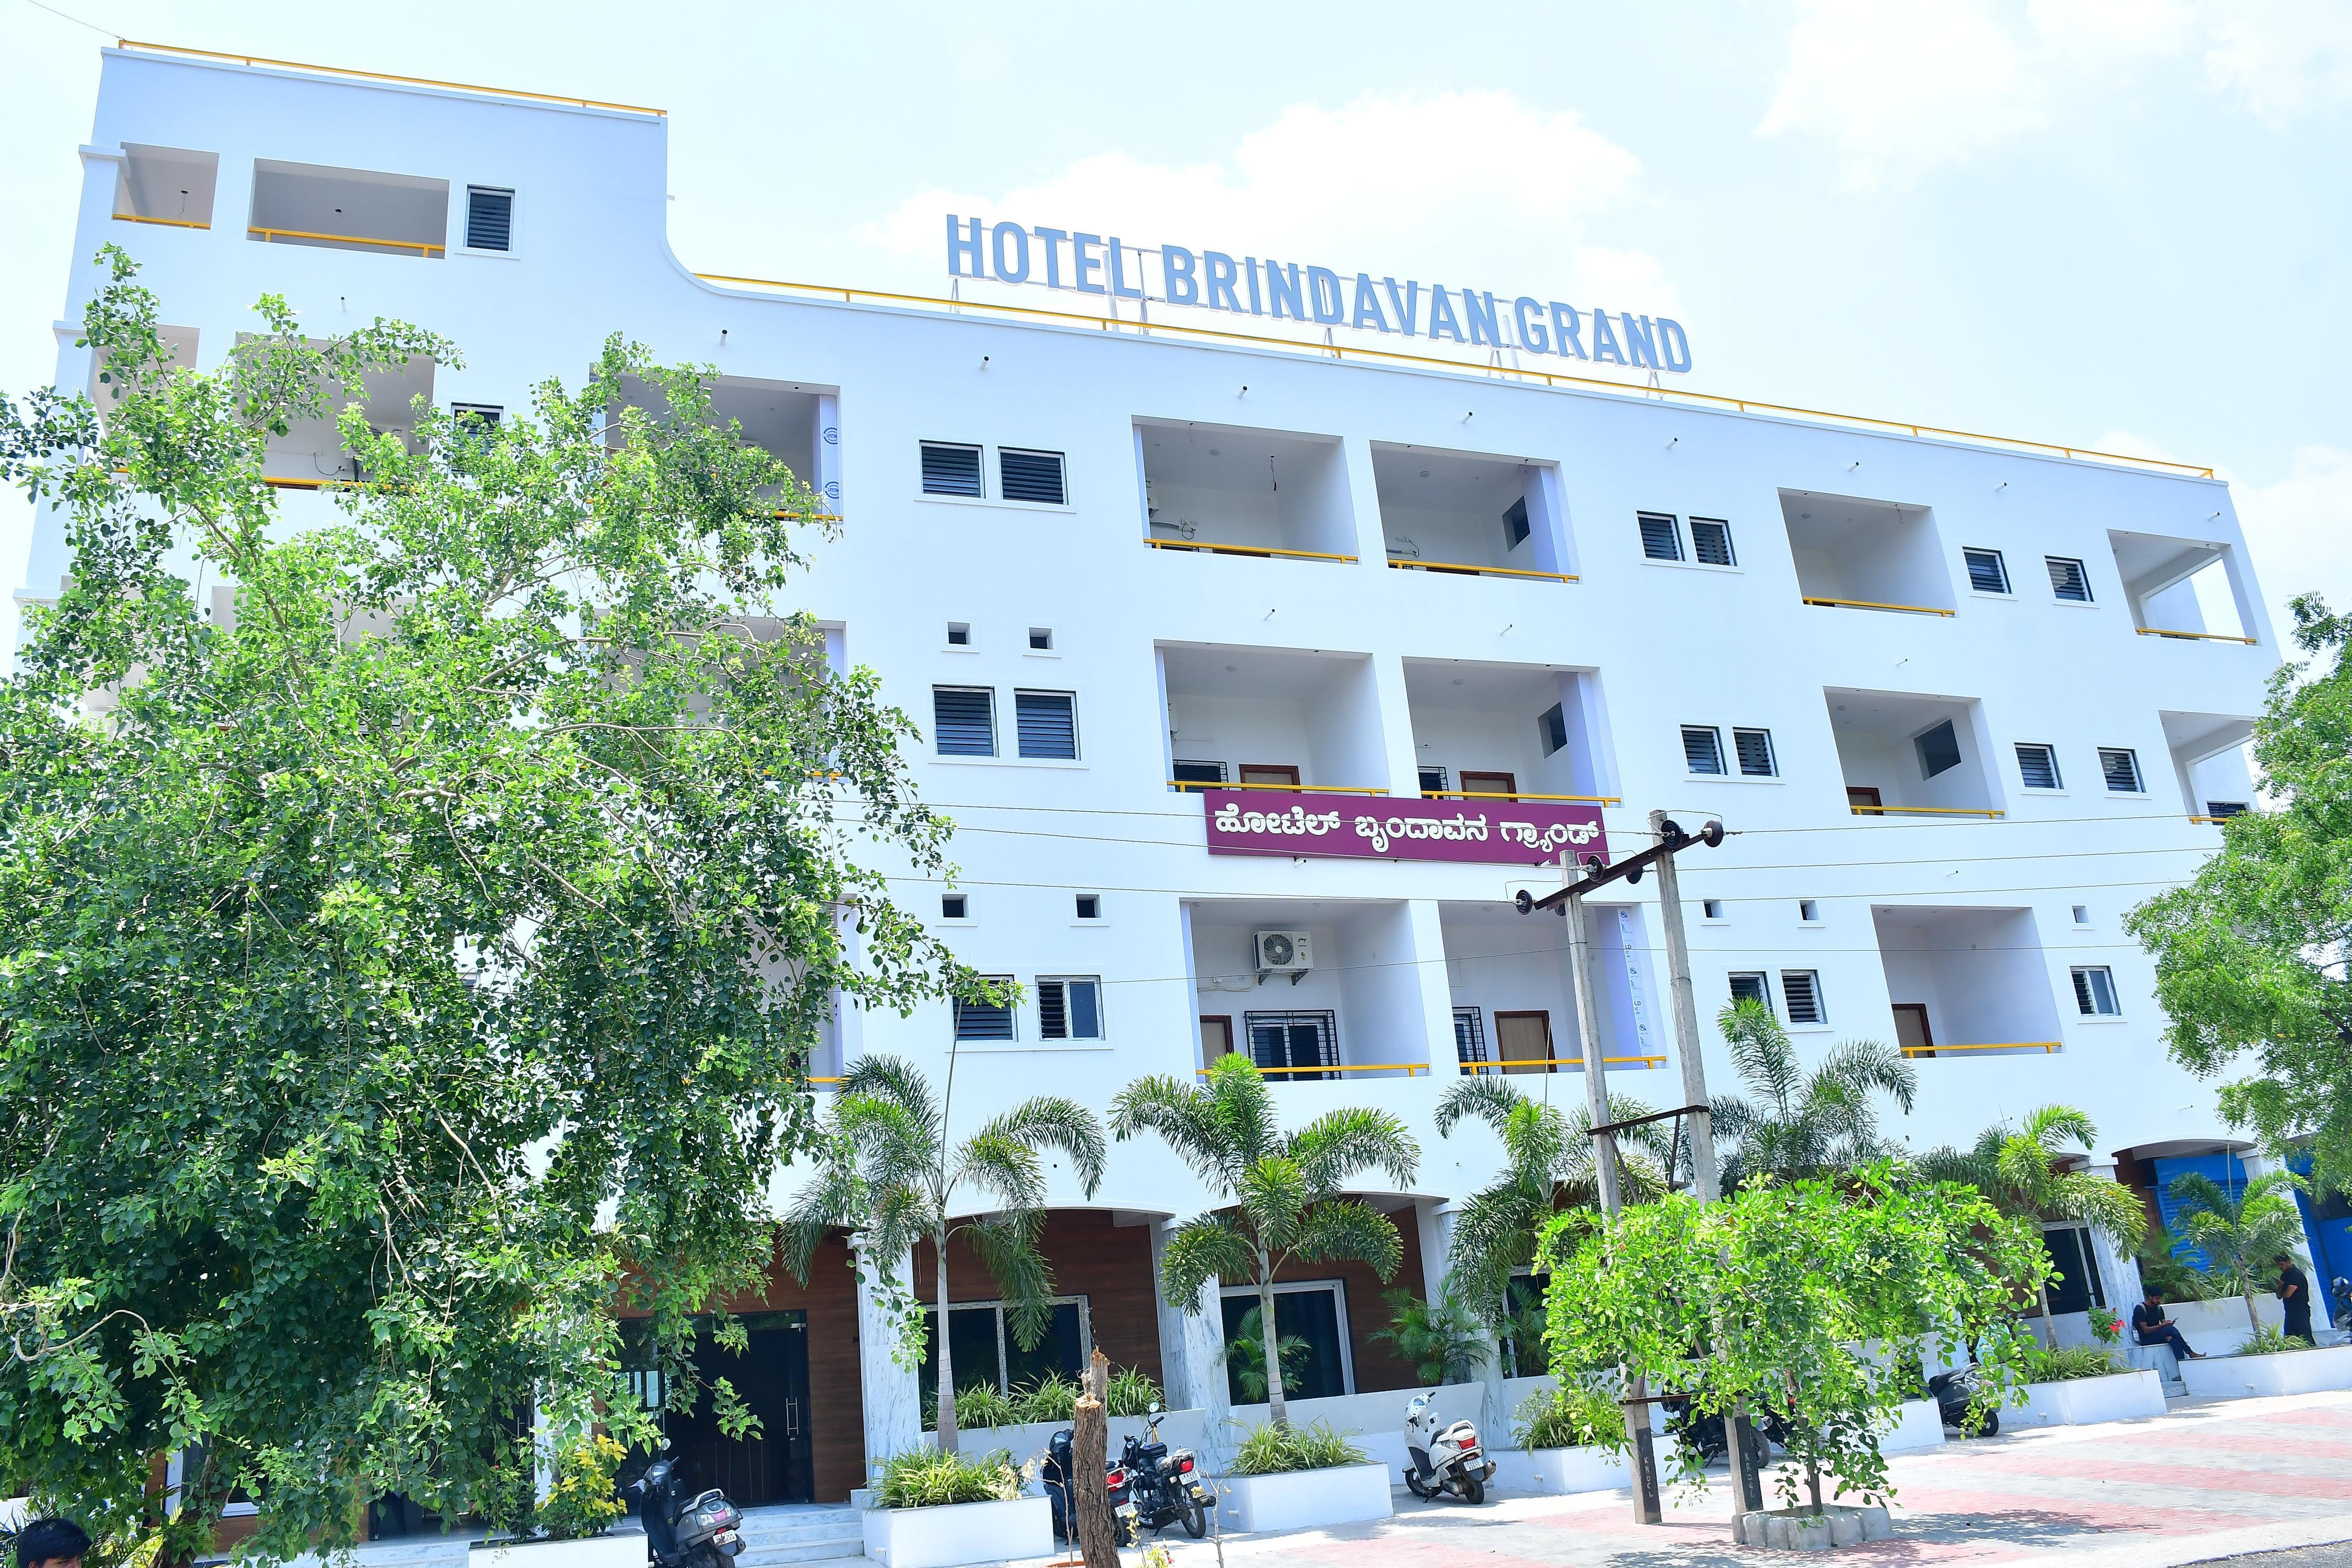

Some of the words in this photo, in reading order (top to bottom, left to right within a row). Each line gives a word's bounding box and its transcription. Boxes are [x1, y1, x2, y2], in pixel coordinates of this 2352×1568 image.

[946, 214, 1142, 300] HOTEL
[1161, 244, 1502, 349] BRINDAVAN
[1517, 296, 1692, 374] GRAND
[1214, 803, 1341, 836] ಹೋಟೆಲ್
[1354, 812, 1489, 852] ಬೃಂದಾವನ
